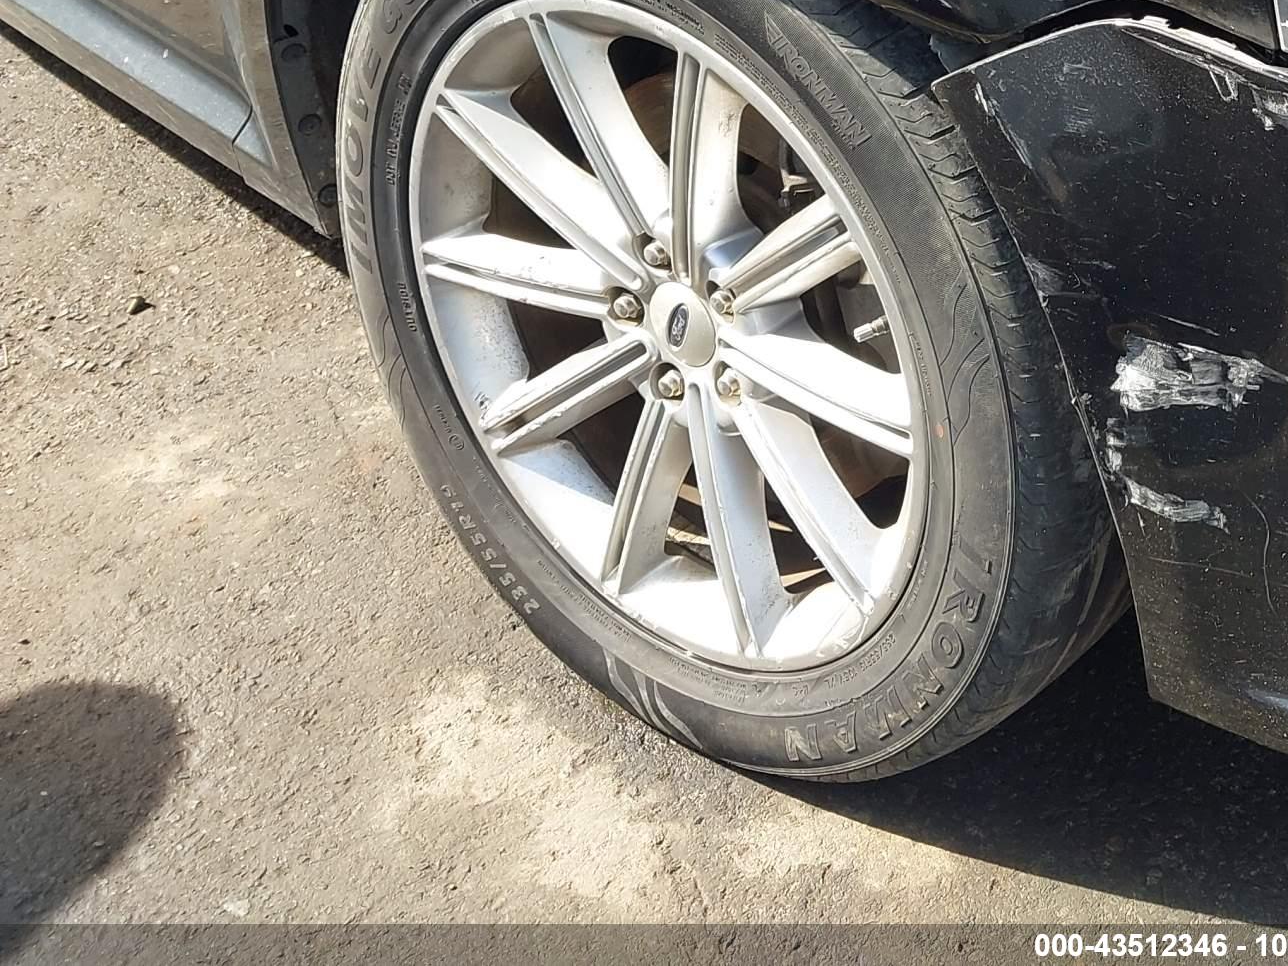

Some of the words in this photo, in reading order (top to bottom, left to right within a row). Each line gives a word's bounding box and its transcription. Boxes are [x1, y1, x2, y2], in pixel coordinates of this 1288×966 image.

[772, 34, 873, 148] IRONMAN
[438, 484, 542, 615] 235/55R19
[784, 536, 994, 762] IRONMAN
